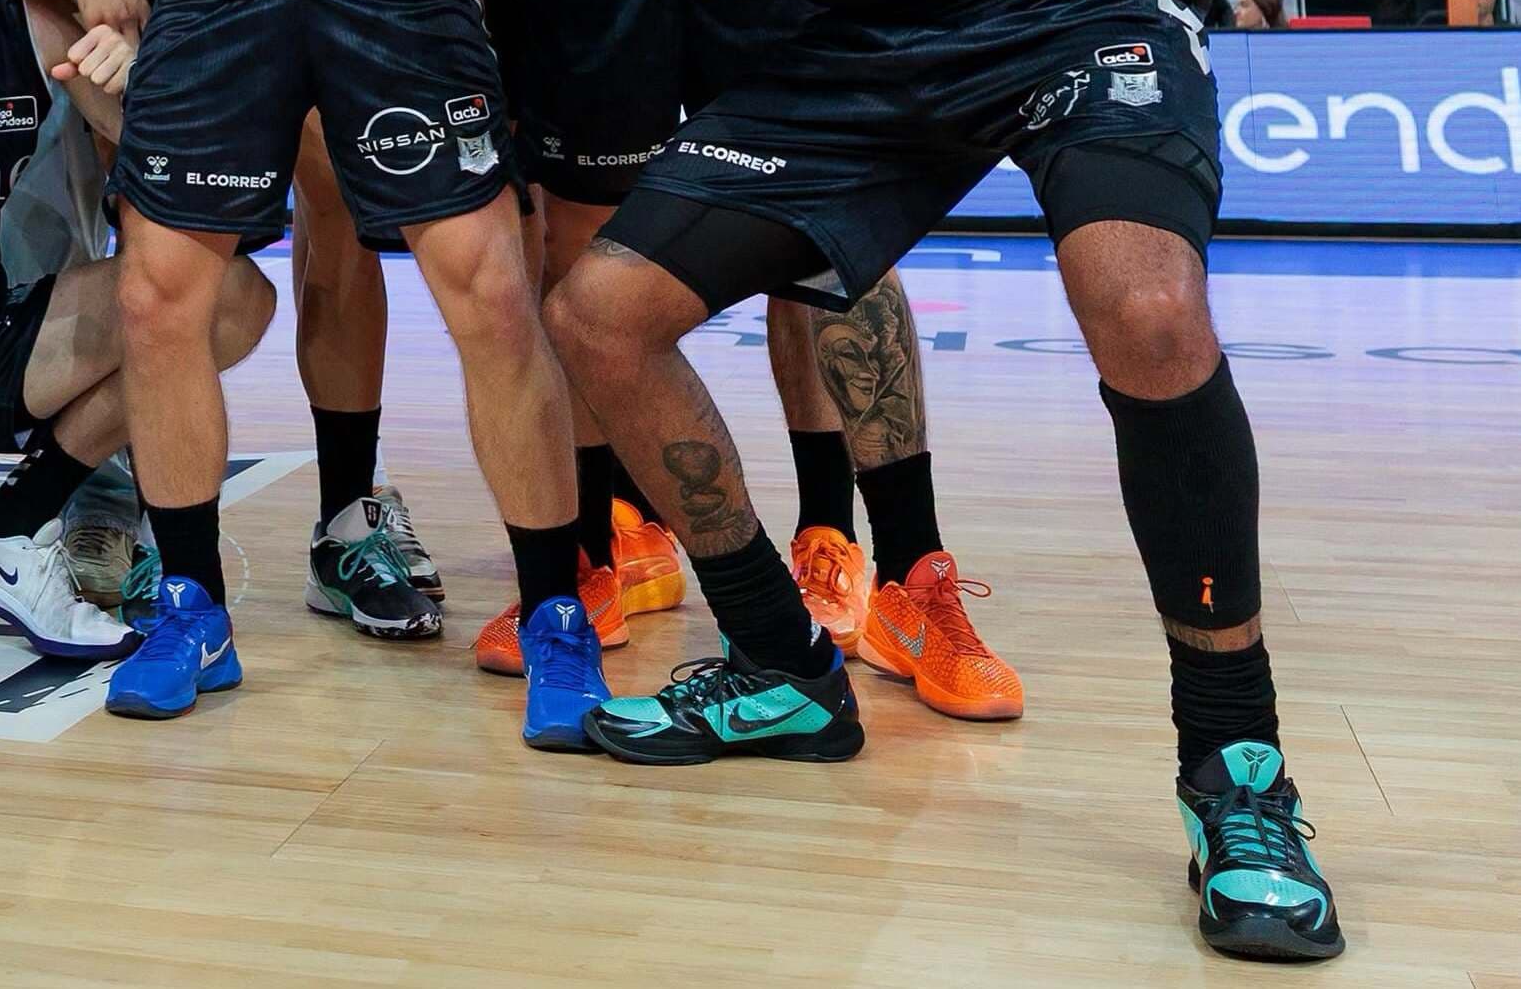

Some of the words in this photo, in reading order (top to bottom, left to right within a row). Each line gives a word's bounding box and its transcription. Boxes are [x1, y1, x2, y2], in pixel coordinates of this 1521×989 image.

[1102, 51, 1140, 64] acb
[452, 104, 480, 121] acb
[357, 127, 446, 154] NISSAN
[578, 155, 596, 166] EL
[678, 142, 700, 155] EL
[701, 144, 777, 175] CORREO
[186, 172, 206, 186] EL
[207, 173, 272, 189] CORREO
